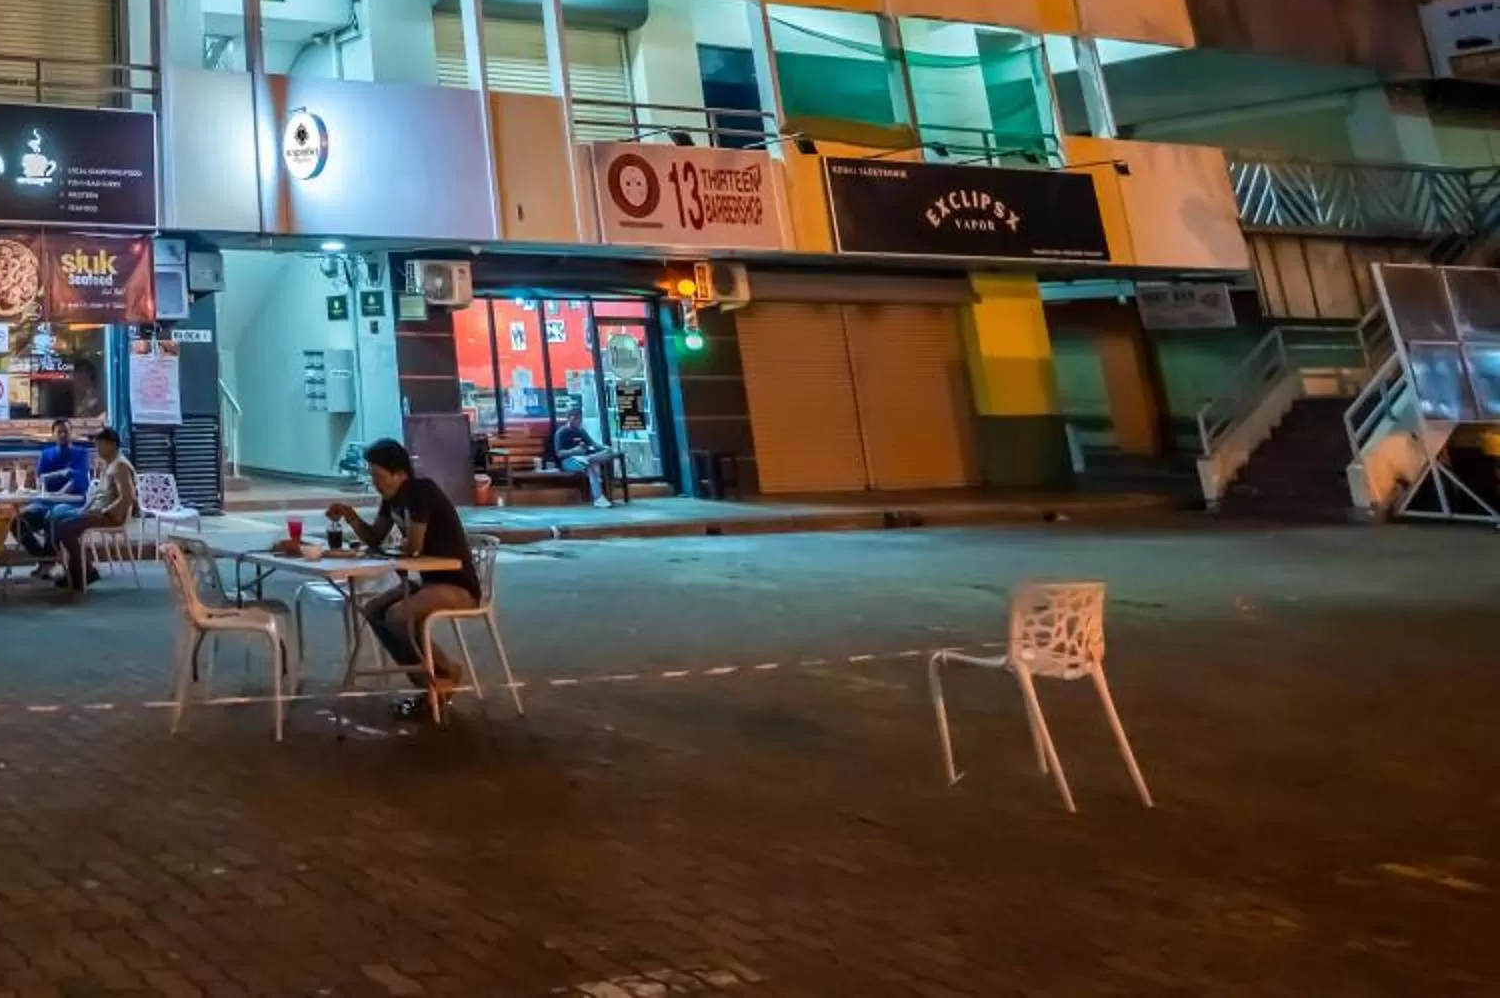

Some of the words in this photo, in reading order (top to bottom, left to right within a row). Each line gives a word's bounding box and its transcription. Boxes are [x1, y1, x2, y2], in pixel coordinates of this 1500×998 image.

[701, 163, 763, 193] THIRTEEN
[668, 161, 705, 231] 13
[954, 218, 996, 232] VAPOR
